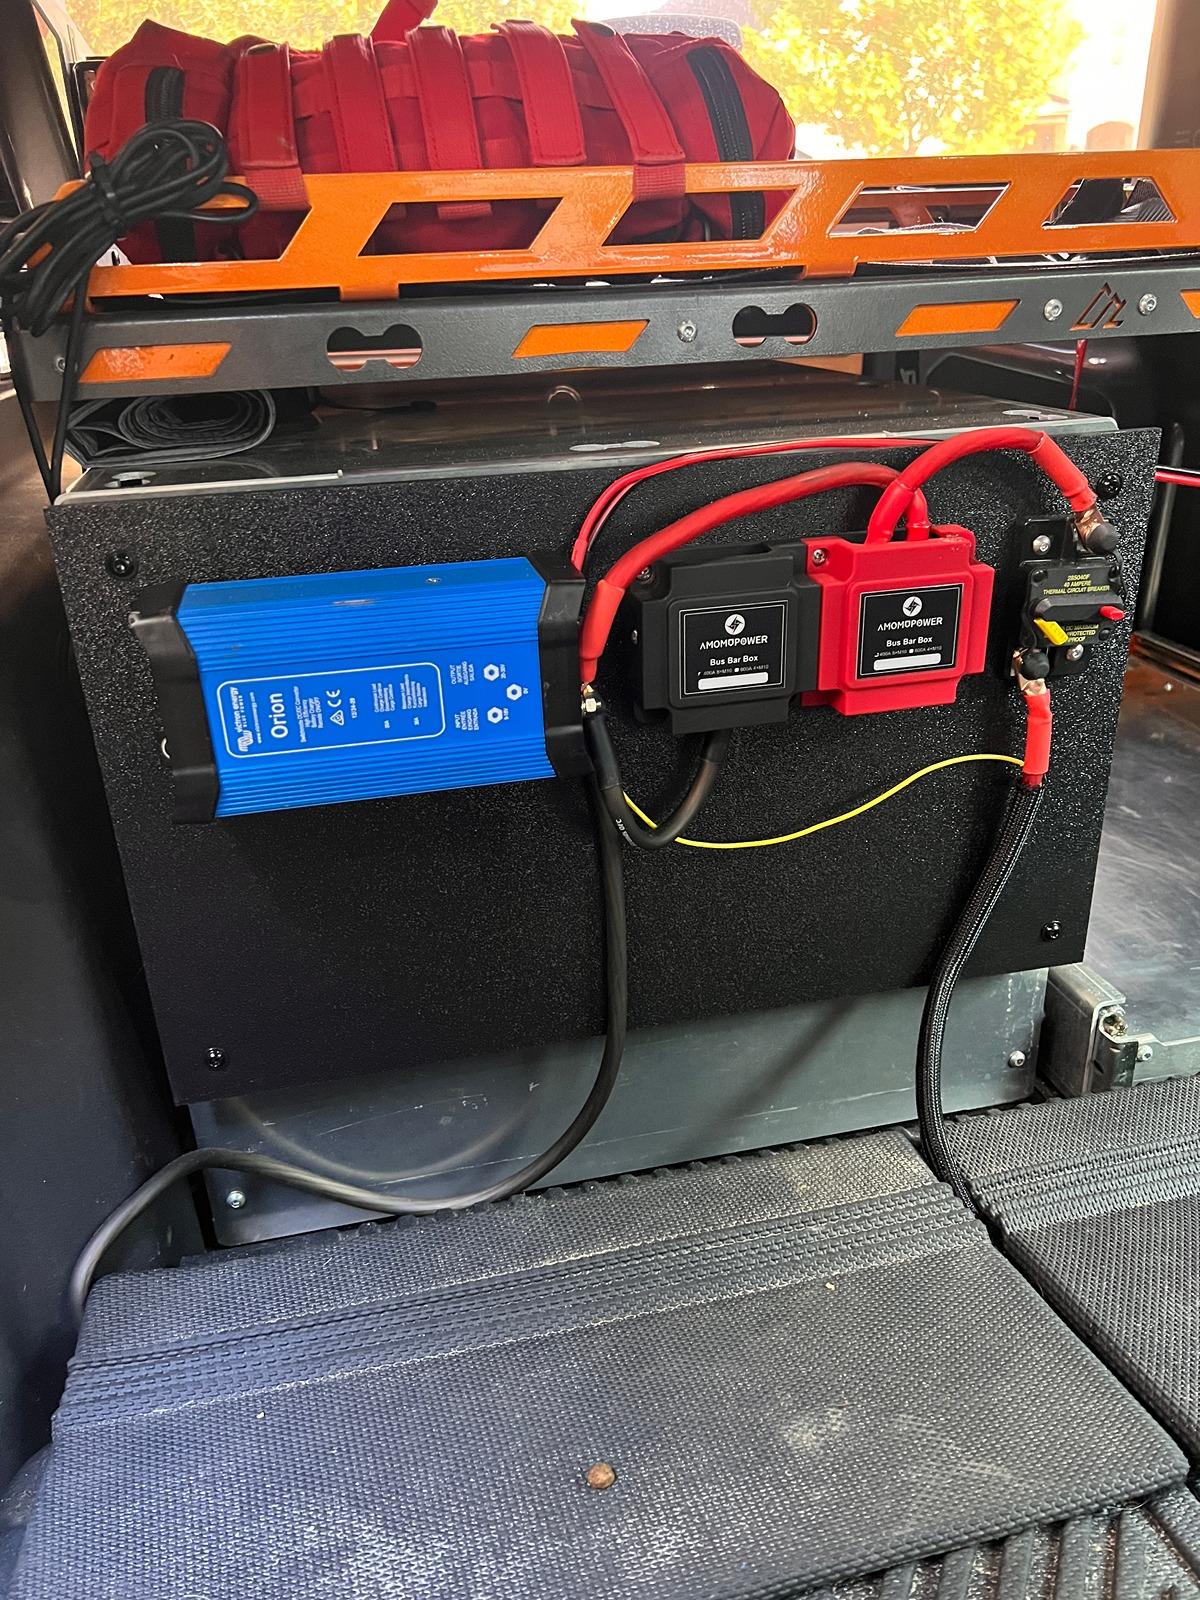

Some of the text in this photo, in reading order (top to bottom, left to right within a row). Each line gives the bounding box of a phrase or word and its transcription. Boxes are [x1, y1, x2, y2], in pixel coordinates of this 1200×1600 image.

[886, 636, 933, 648] Bus Bar Box
[710, 658, 725, 666] Bus
[727, 656, 742, 664] Bar
[230, 687, 243, 733] victron energy
[266, 693, 289, 739] Orion
